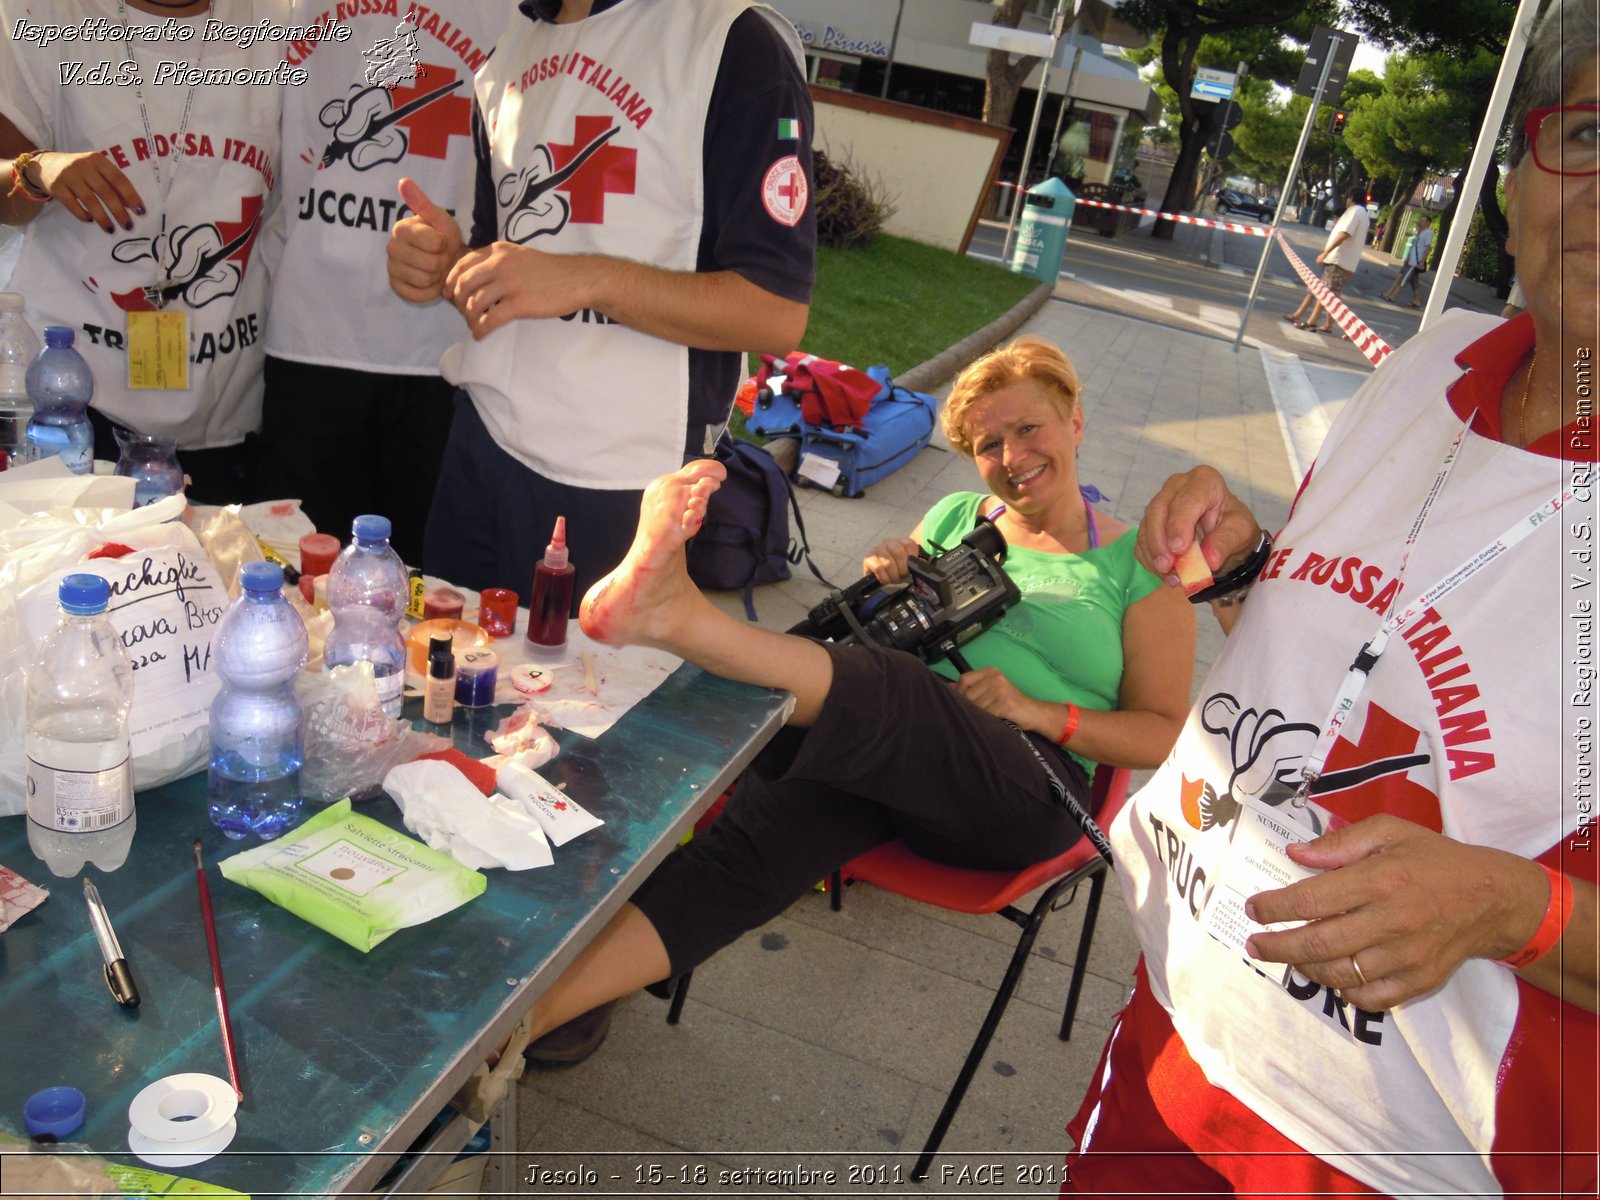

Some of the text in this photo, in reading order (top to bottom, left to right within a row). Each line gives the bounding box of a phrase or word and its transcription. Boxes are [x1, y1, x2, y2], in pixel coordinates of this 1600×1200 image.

[823, 26, 887, 56] Pizzeria
[566, 52, 653, 130] ITALIANA
[1528, 498, 1563, 527] FACE
[946, 548, 966, 563] SONY
[1289, 551, 1405, 617] ROSSA
[1330, 697, 1353, 729] FACE
[528, 793, 558, 821] TRUCCATORI
[1256, 814, 1290, 841] NUMERI
[343, 823, 436, 872] Salviette struccanti
[1244, 855, 1273, 880] GIUSEPPE
[1262, 858, 1292, 880] REFERENTE
[1215, 906, 1248, 934] Emergency
[1218, 900, 1237, 916] Police
